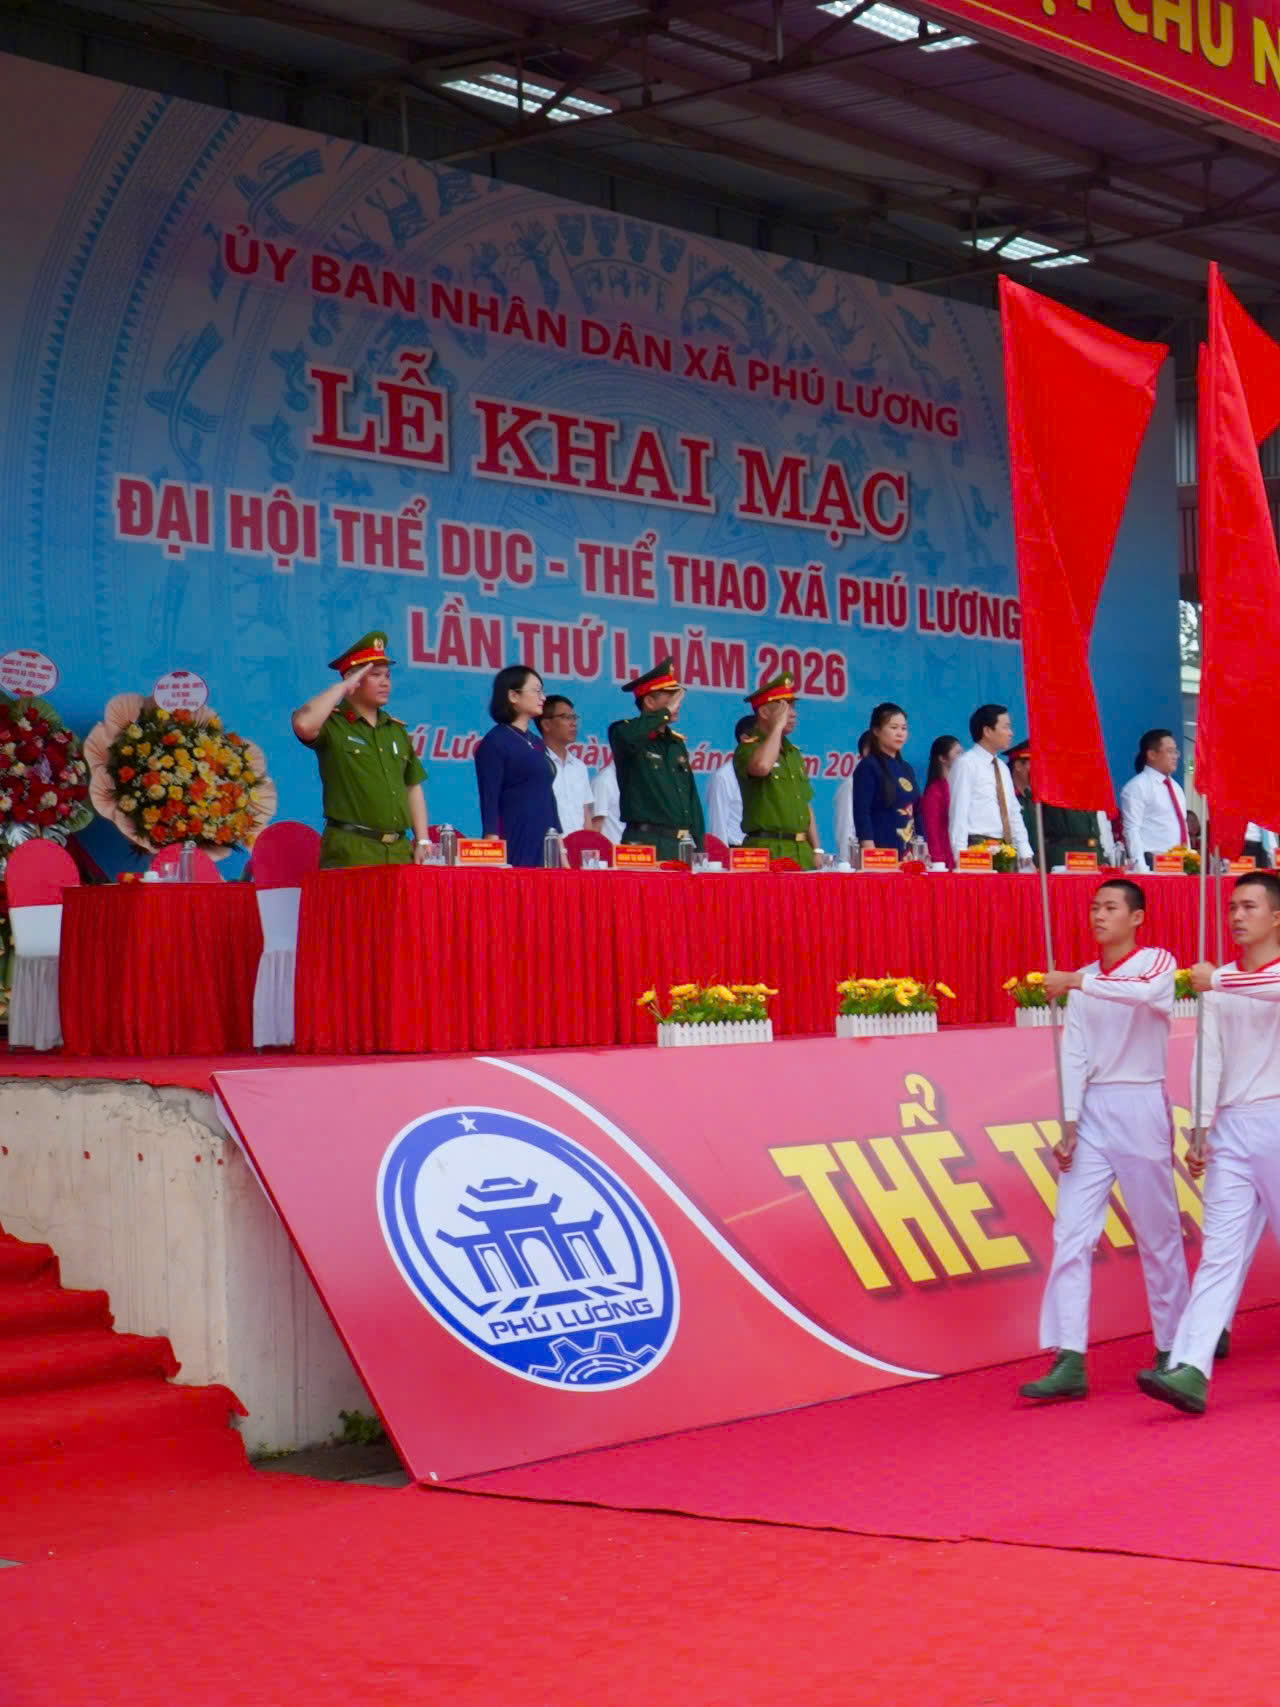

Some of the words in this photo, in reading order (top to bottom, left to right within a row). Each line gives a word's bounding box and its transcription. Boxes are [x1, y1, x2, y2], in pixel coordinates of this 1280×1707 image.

[225, 224, 296, 282] ỦY
[311, 254, 415, 312] BAN
[431, 282, 566, 348] NHÂN
[581, 321, 671, 372] DÂN
[684, 344, 735, 386] XÃ
[748, 359, 824, 405] PHÚ
[836, 380, 958, 437] LƯƠNG
[311, 352, 443, 463] LỄ
[475, 400, 711, 506] KHAI
[738, 448, 904, 542] MẠC
[117, 478, 209, 553] ĐẠI
[230, 489, 316, 566] HỘI
[333, 499, 427, 571] THỂ
[441, 523, 532, 591] DỤC
[549, 561, 565, 573] -
[578, 532, 656, 598] THỂ
[667, 555, 768, 612] THAO
[779, 565, 828, 618] XÃ
[839, 576, 907, 628] PHÚ
[918, 587, 1021, 640] LƯƠNG
[411, 598, 500, 668] LẦN
[517, 618, 603, 677] THỨ
[654, 629, 745, 690] NĂM
[759, 647, 845, 697] 2026
[769, 1073, 1031, 1290] THỂ
[488, 1312, 552, 1339] PHÚ
[556, 1298, 654, 1328] LƯƠNG
